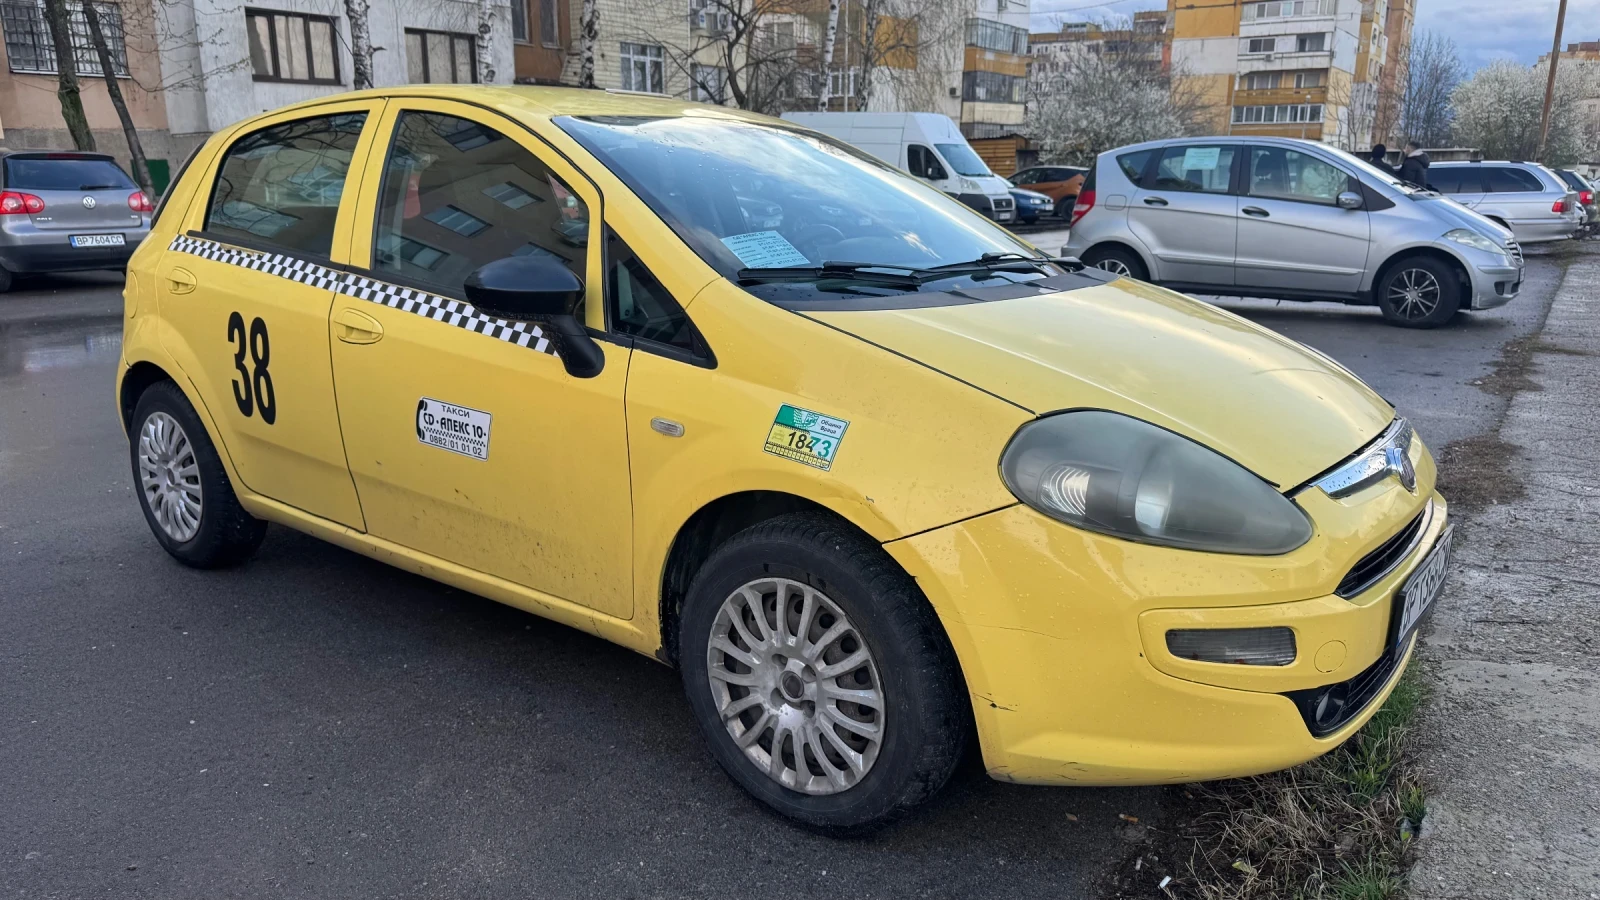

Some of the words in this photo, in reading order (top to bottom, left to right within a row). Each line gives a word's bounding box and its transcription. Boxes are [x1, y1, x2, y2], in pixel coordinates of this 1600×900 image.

[228, 311, 276, 425] 38
[441, 405, 470, 418] ТАКСИ
[440, 417, 470, 436] АПЕКС
[820, 419, 842, 430] Община
[820, 425, 837, 435] Враца
[461, 443, 470, 453] 01
[472, 446, 482, 456] 02
